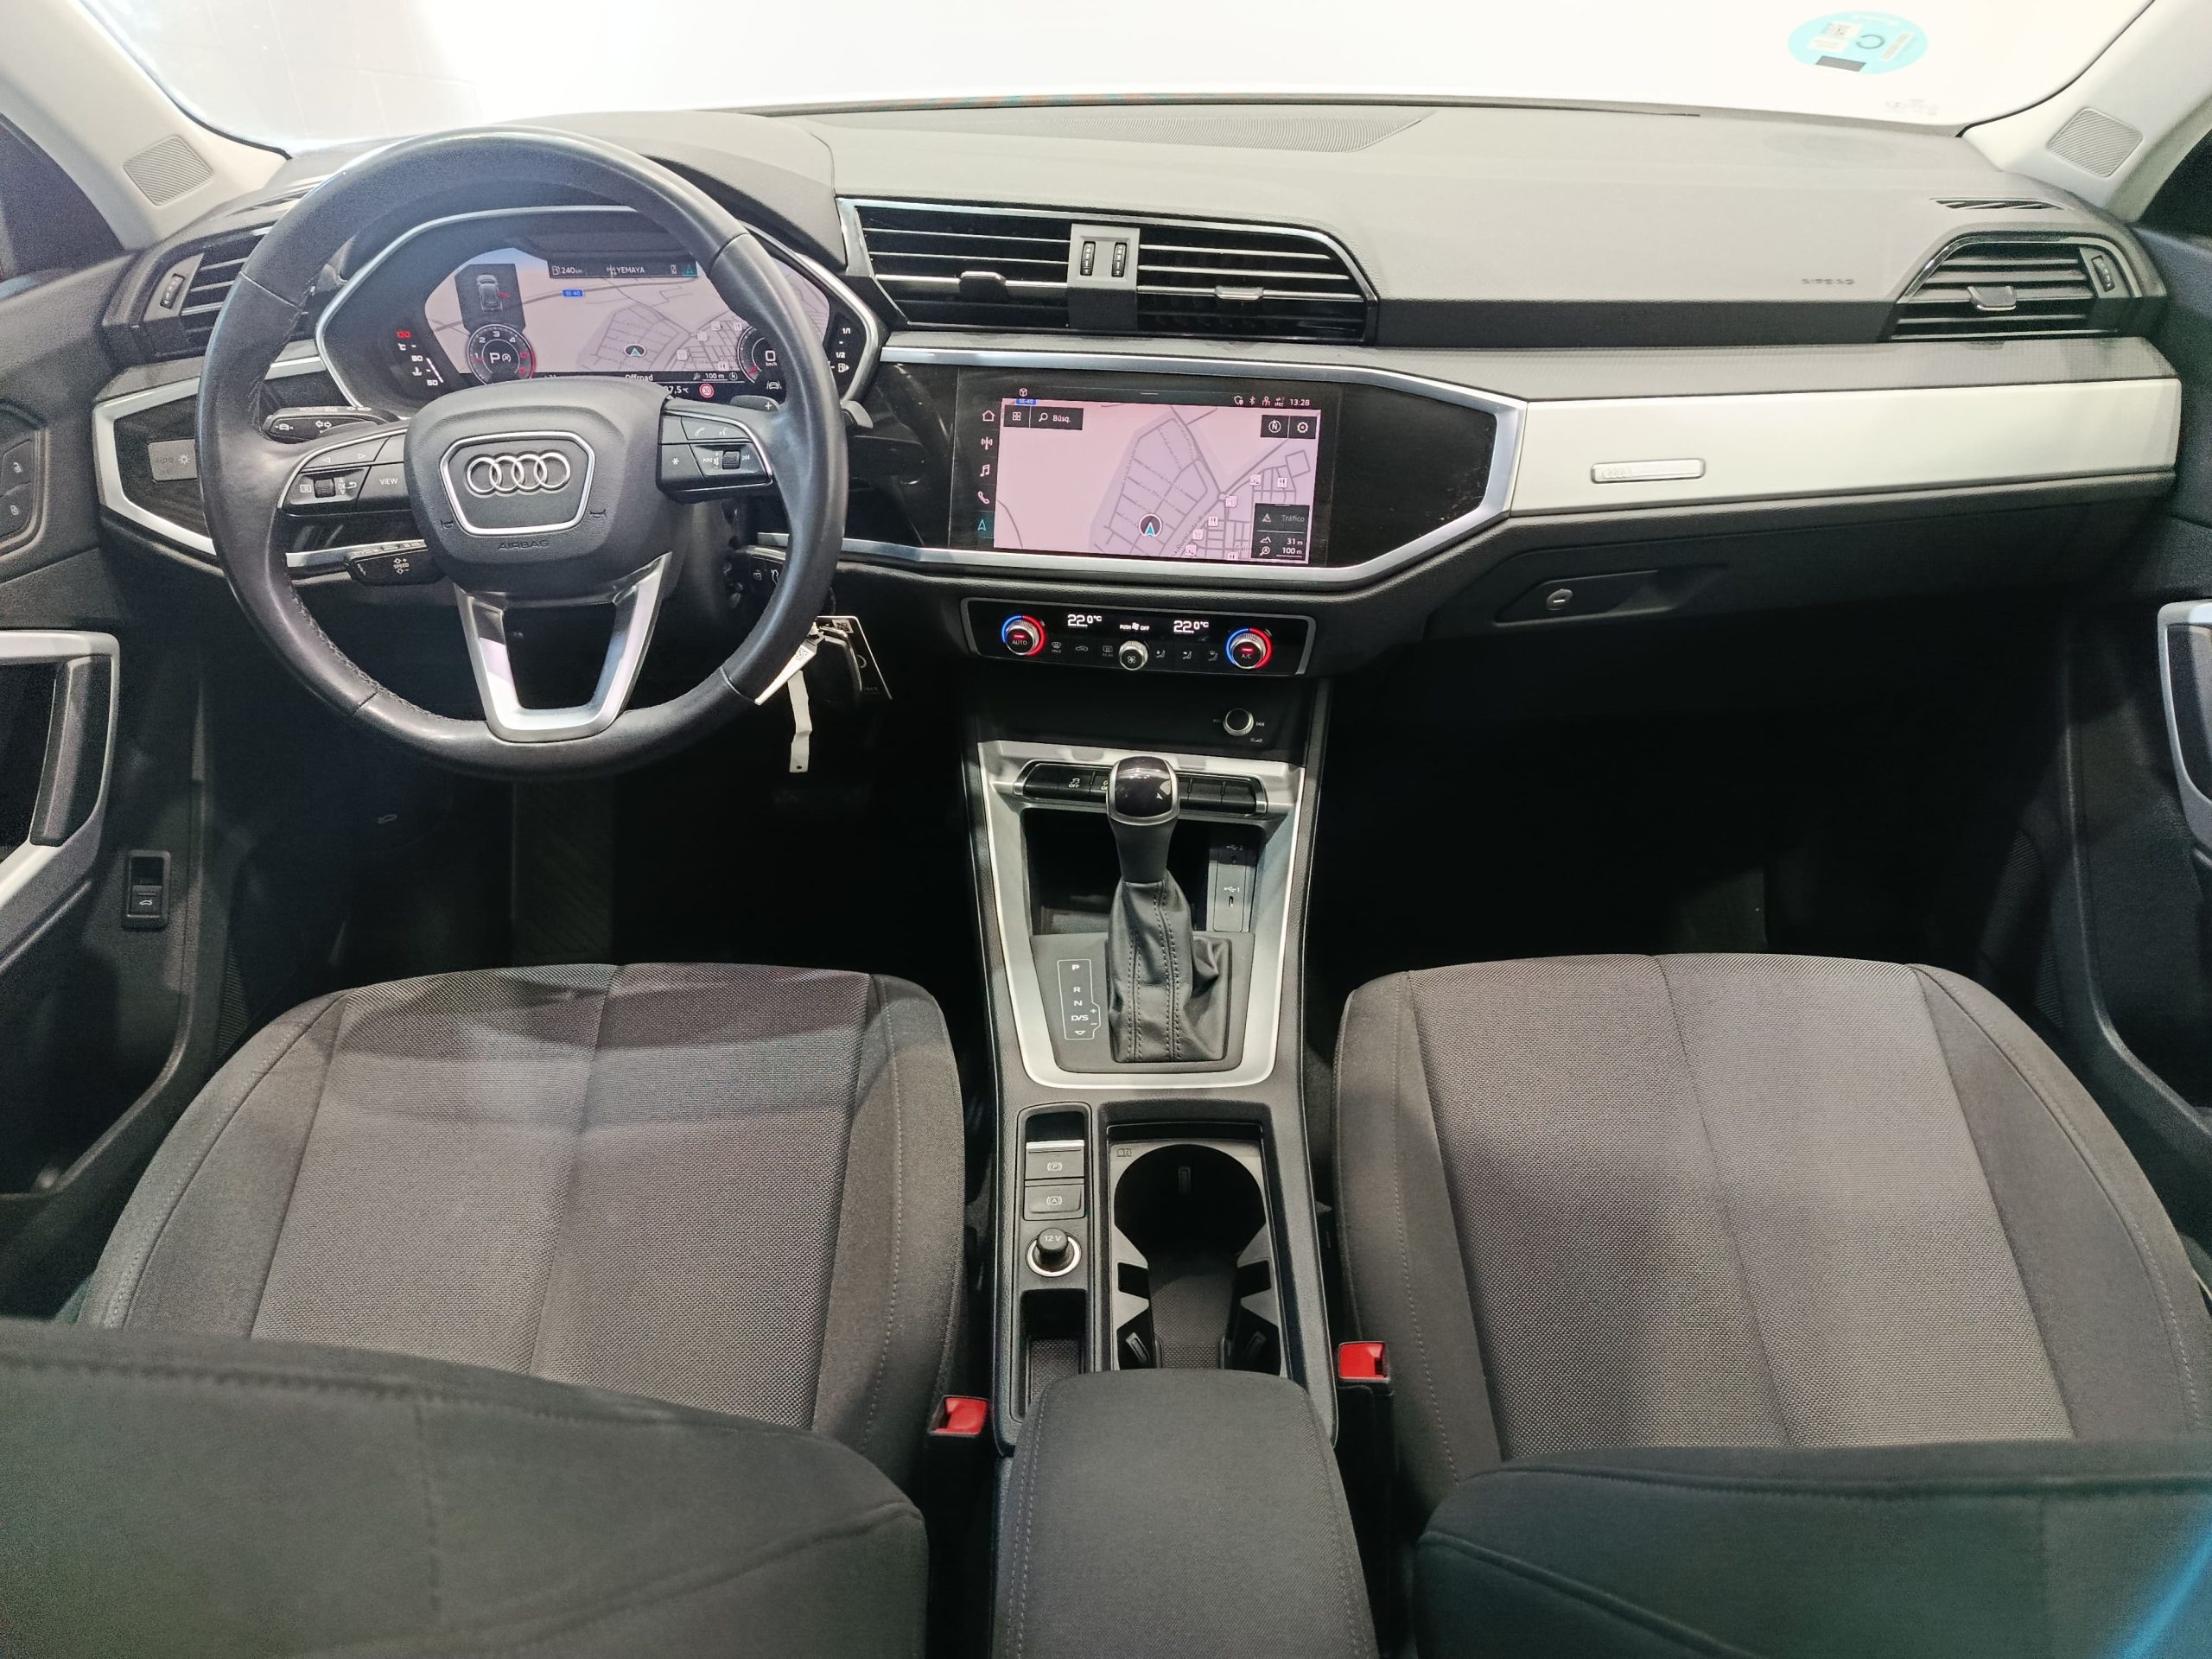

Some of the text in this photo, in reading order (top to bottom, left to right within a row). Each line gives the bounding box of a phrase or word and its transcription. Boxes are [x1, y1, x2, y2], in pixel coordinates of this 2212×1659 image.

[489, 353, 500, 364] P
[1052, 414, 1071, 423] Búsq.
[379, 477, 398, 486] VIEW
[498, 539, 550, 550] AIRBAG
